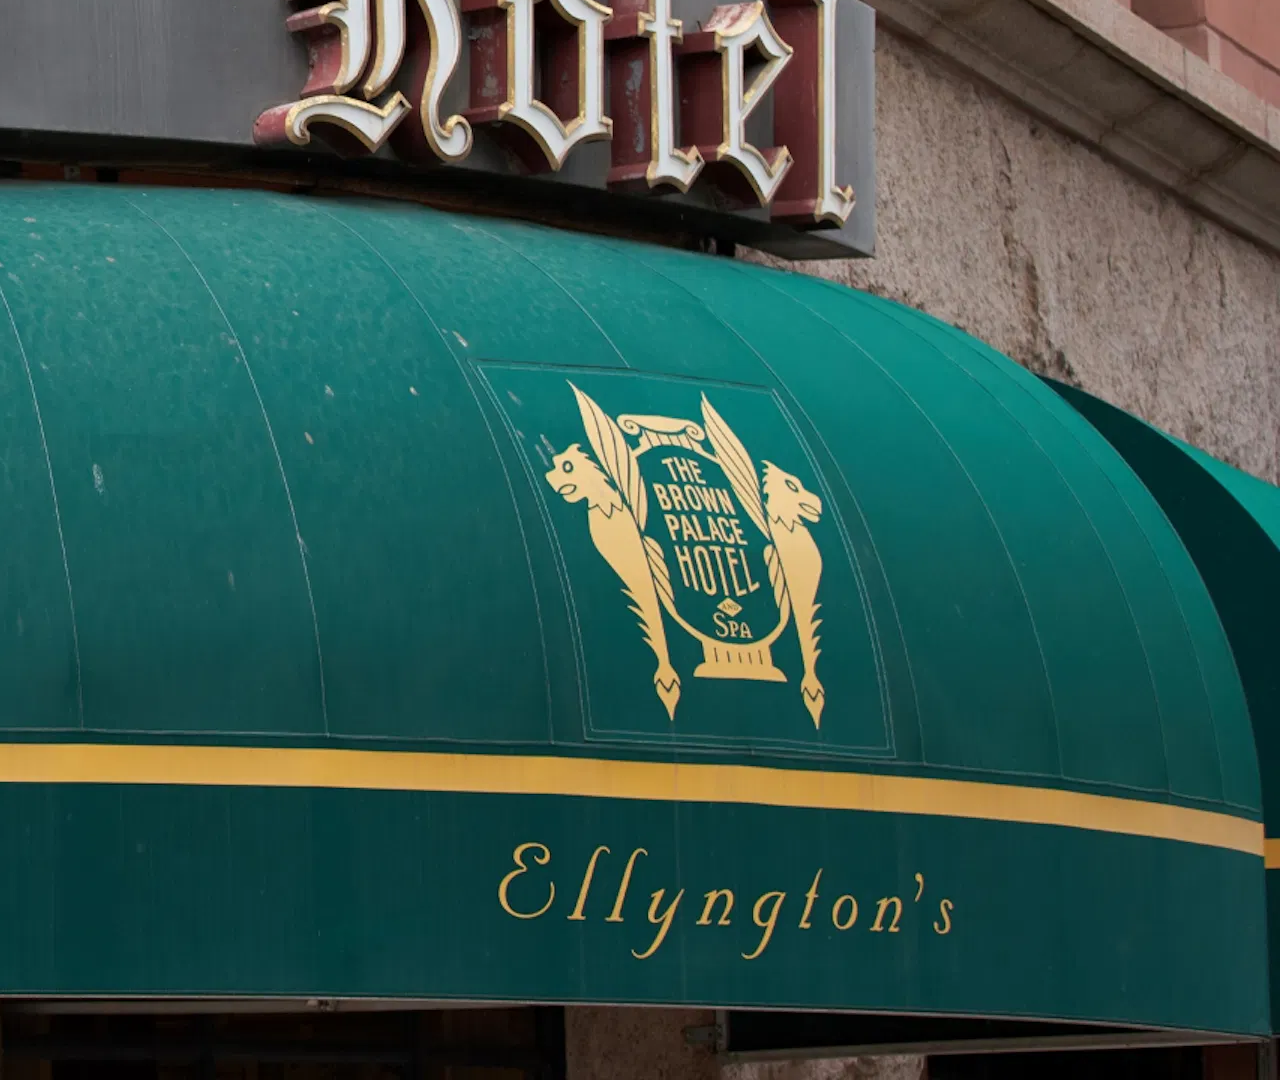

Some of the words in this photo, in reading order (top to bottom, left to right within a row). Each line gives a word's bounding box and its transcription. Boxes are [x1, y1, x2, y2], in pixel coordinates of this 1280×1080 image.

[661, 457, 706, 483] THE
[654, 484, 736, 515] BROWN
[665, 514, 748, 545] PALACE
[674, 544, 761, 597] HOTEL
[497, 842, 955, 960] Ellyngton's
